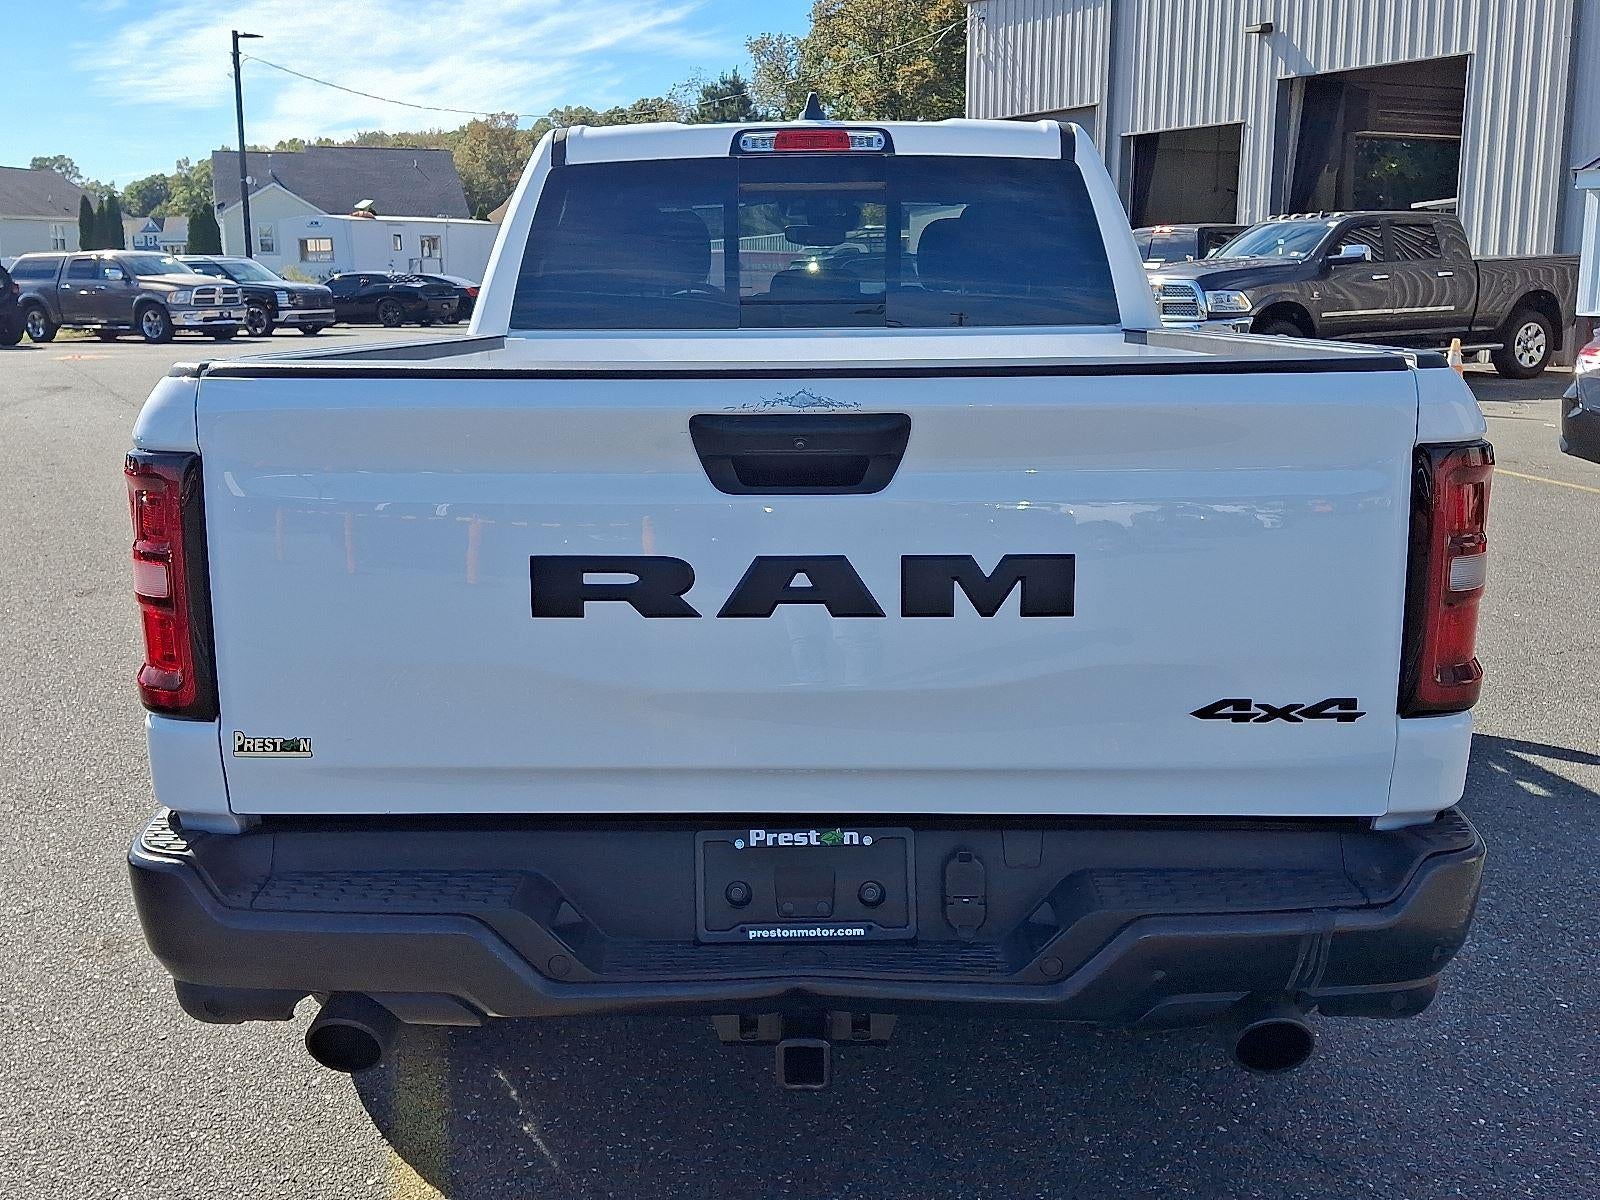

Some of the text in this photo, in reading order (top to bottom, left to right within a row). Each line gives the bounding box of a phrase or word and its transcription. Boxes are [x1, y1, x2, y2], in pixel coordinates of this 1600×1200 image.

[530, 553, 1075, 619] RAM
[1189, 697, 1367, 723] 4x4
[234, 731, 311, 752] PRESTN
[749, 827, 859, 847] Prestn
[748, 927, 865, 940] prestonmotor.com
